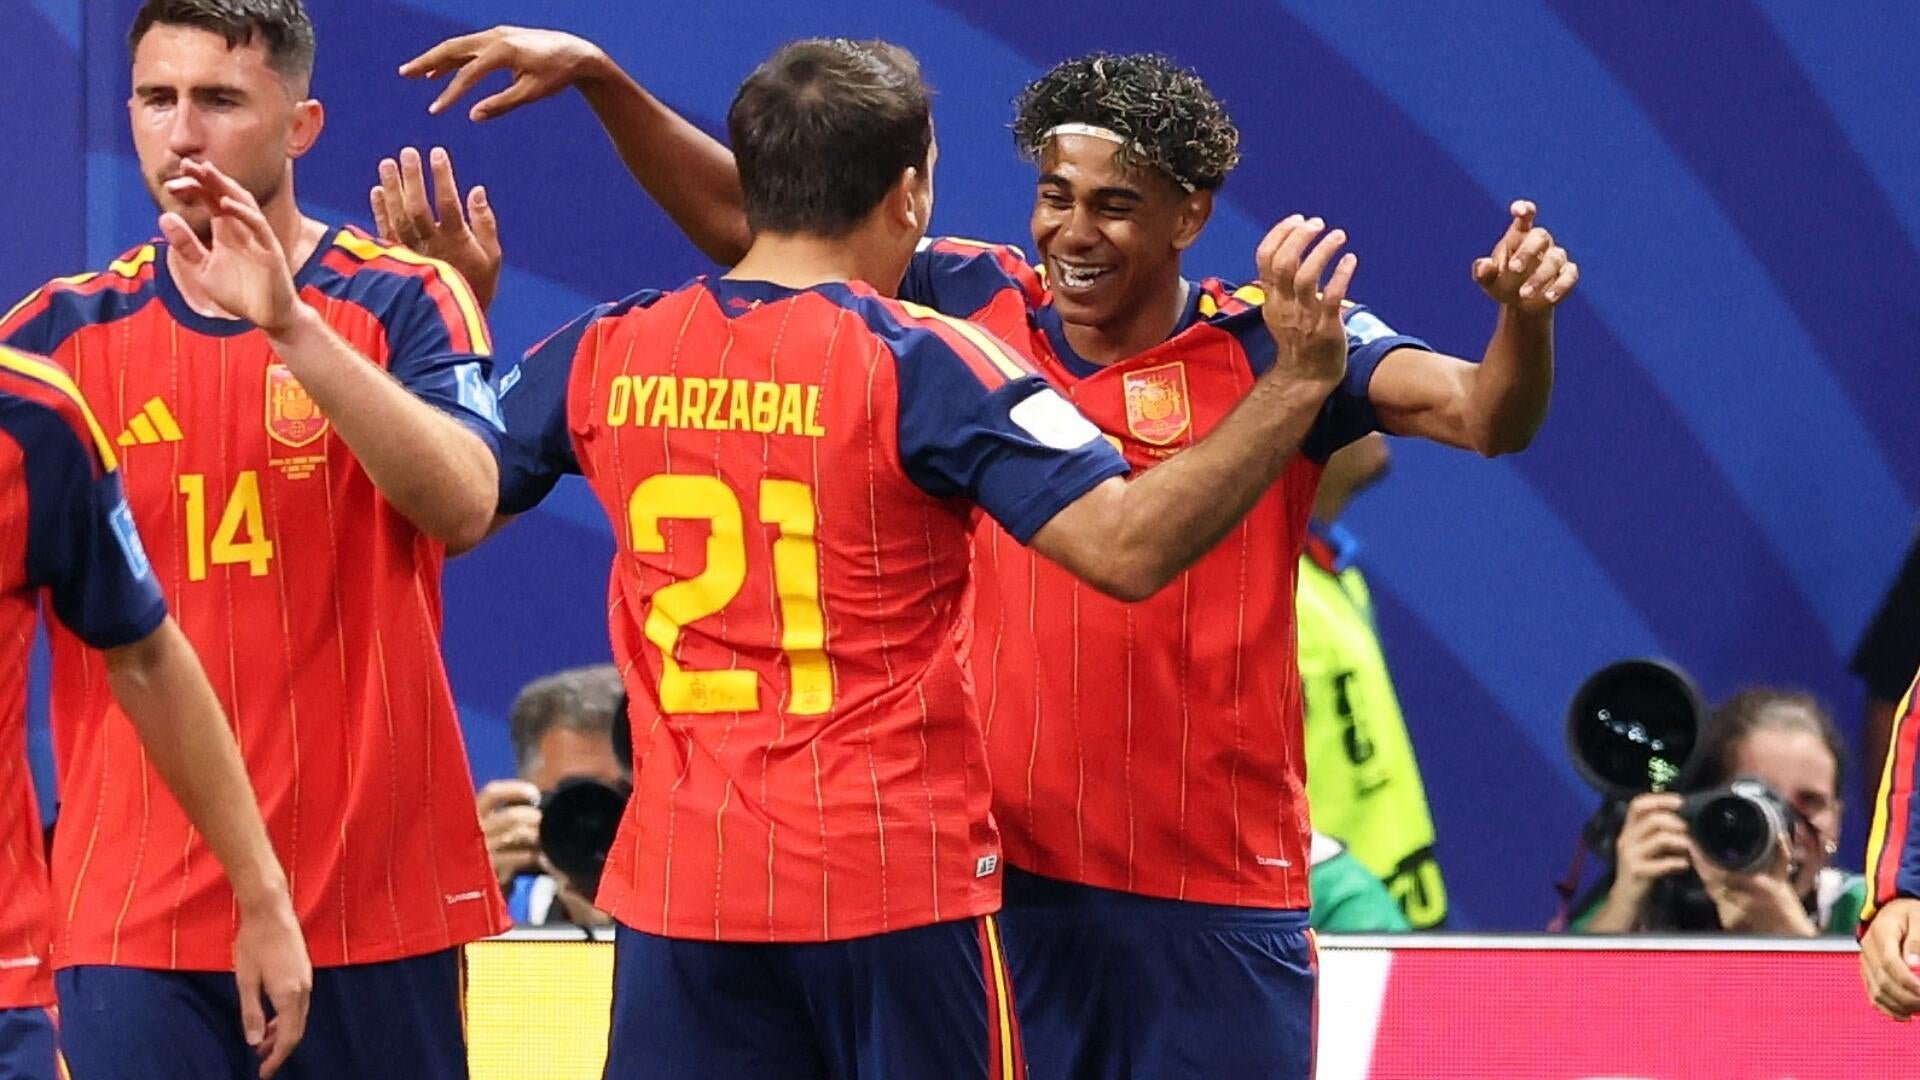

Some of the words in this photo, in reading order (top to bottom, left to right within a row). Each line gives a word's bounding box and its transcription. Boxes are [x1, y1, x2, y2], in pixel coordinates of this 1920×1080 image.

[607, 375, 825, 437] OYARZABAL
[179, 470, 273, 581] 14
[629, 474, 833, 715] 21
